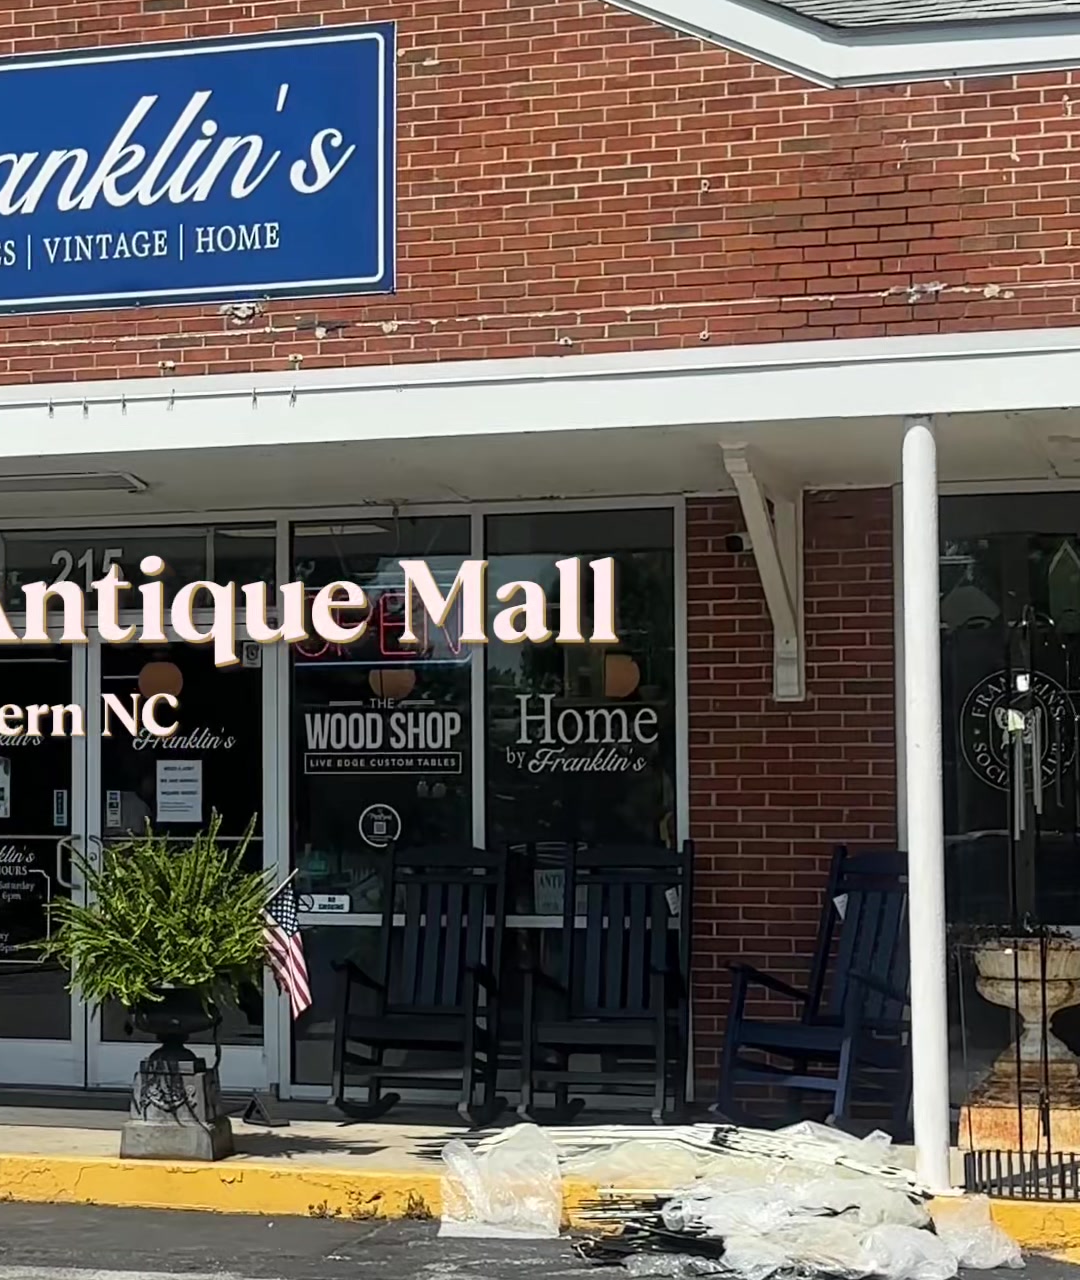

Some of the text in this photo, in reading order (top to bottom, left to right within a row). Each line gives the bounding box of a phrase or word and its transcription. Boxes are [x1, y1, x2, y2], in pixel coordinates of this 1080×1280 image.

[43, 229, 168, 265] VINTAGE
[195, 222, 281, 254] HOME
[51, 548, 124, 593] 215
[295, 593, 462, 657] PEN
[370, 698, 396, 709] THE
[515, 693, 659, 744] Home
[132, 726, 237, 751] Franklin's
[304, 712, 462, 749] WOOD SHOP
[310, 758, 456, 767] LIVE EDGE CUSTOM TABLES
[506, 746, 647, 773] by Franklin's
